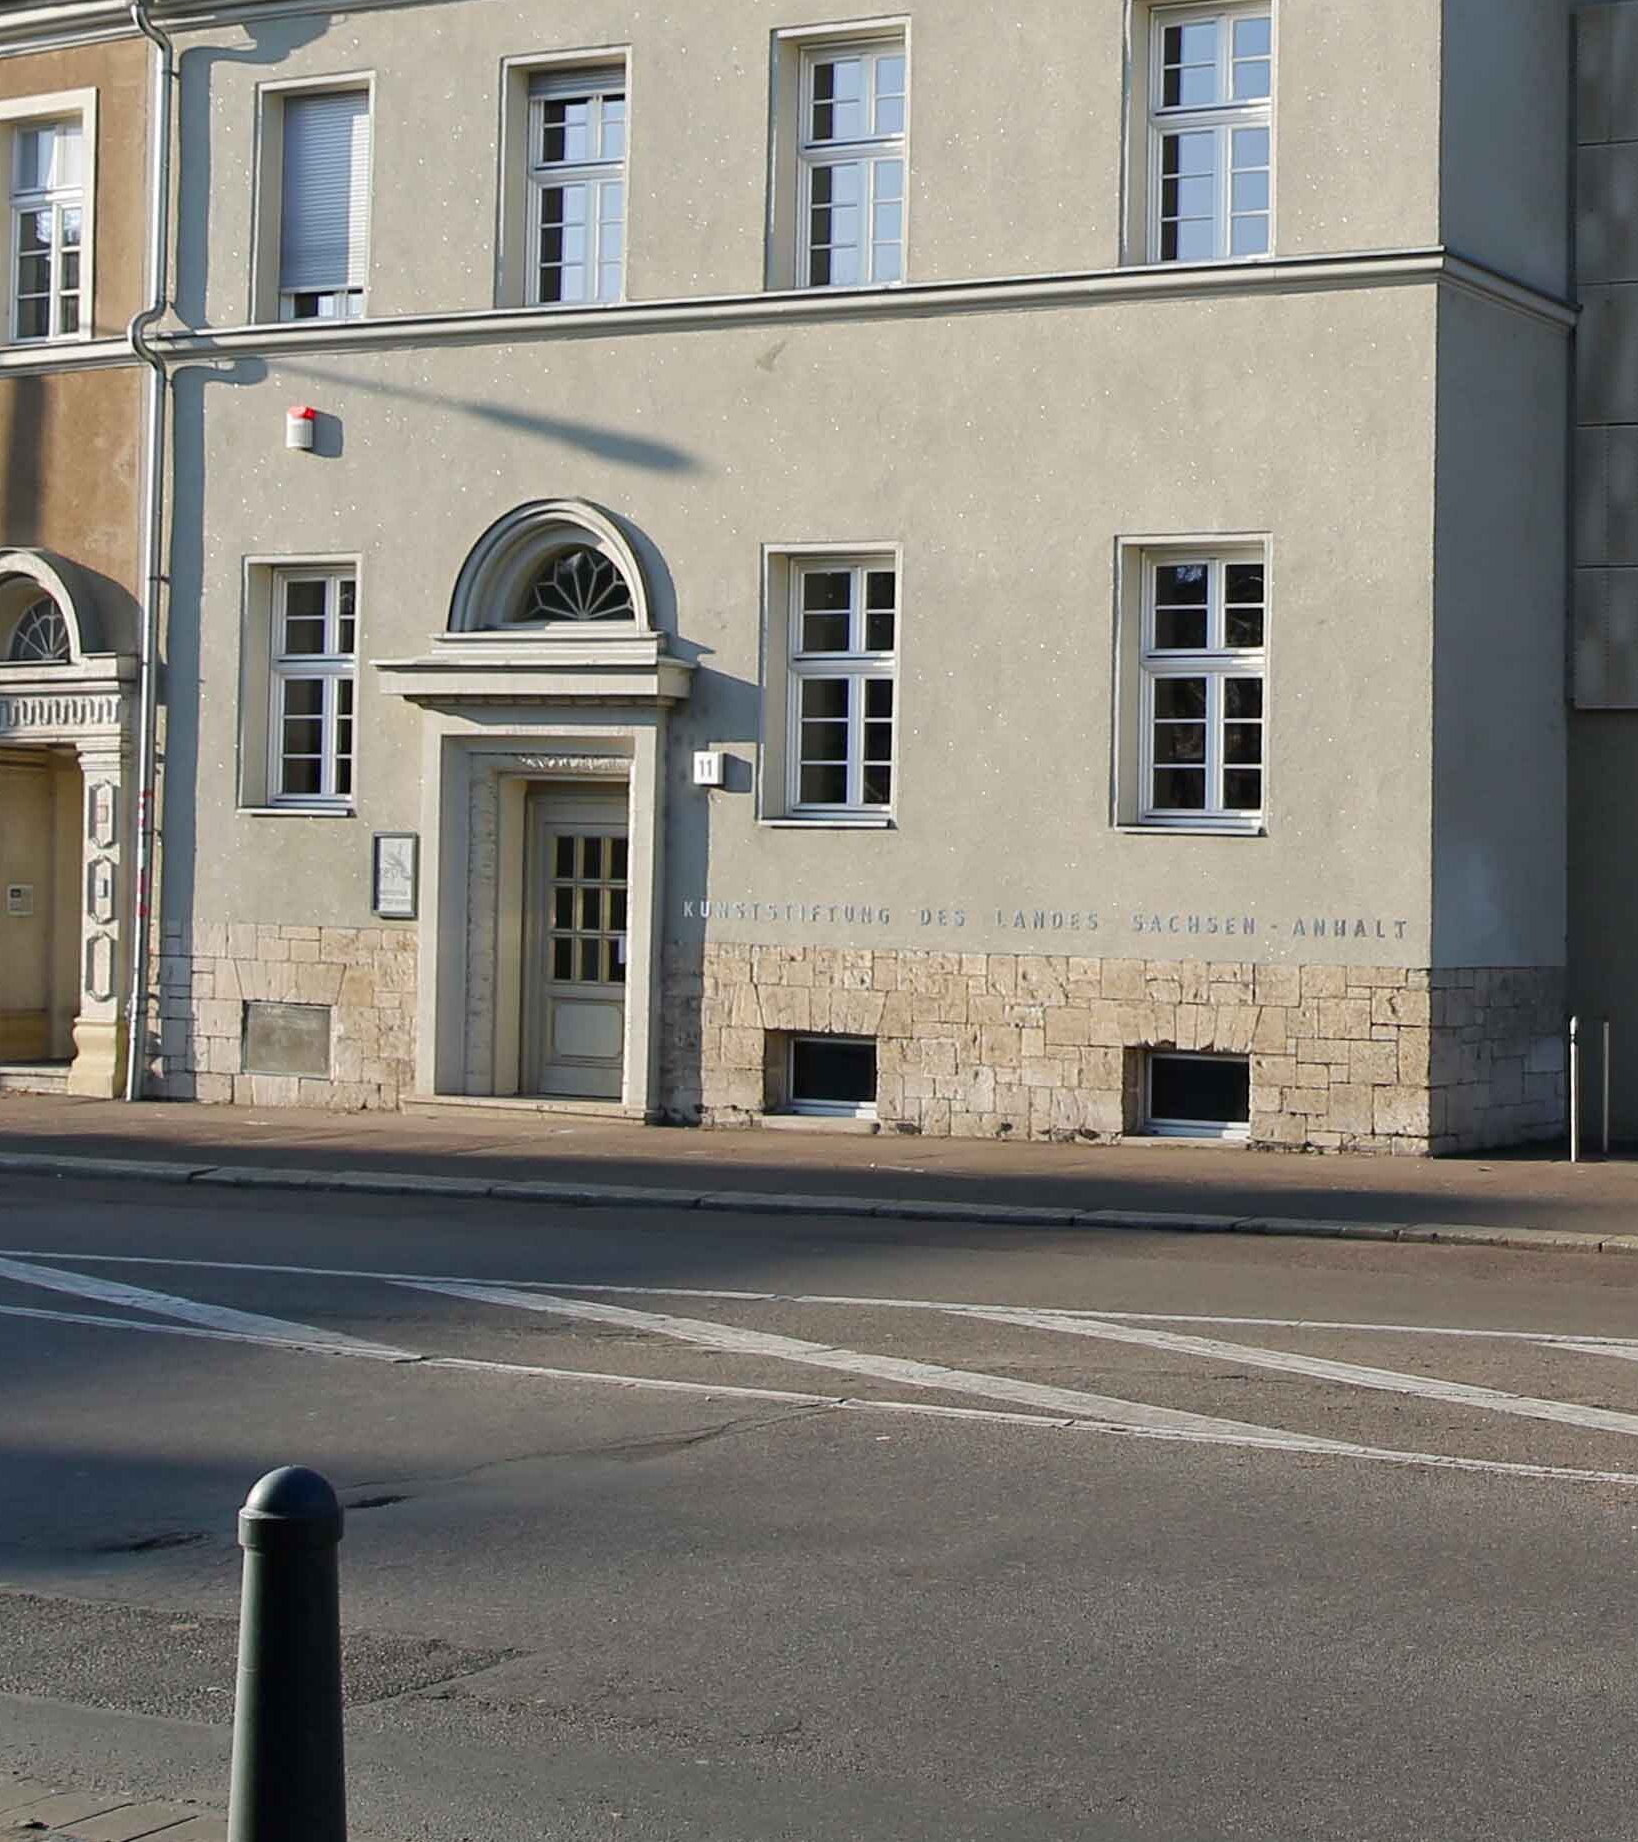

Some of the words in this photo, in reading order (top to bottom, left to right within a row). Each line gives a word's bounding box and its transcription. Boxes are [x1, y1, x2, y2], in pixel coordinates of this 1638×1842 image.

[698, 759, 712, 777] 11
[682, 900, 891, 925] KUNSTSTIFTUNG
[920, 909, 966, 927] DES
[996, 909, 1098, 931] LANDES
